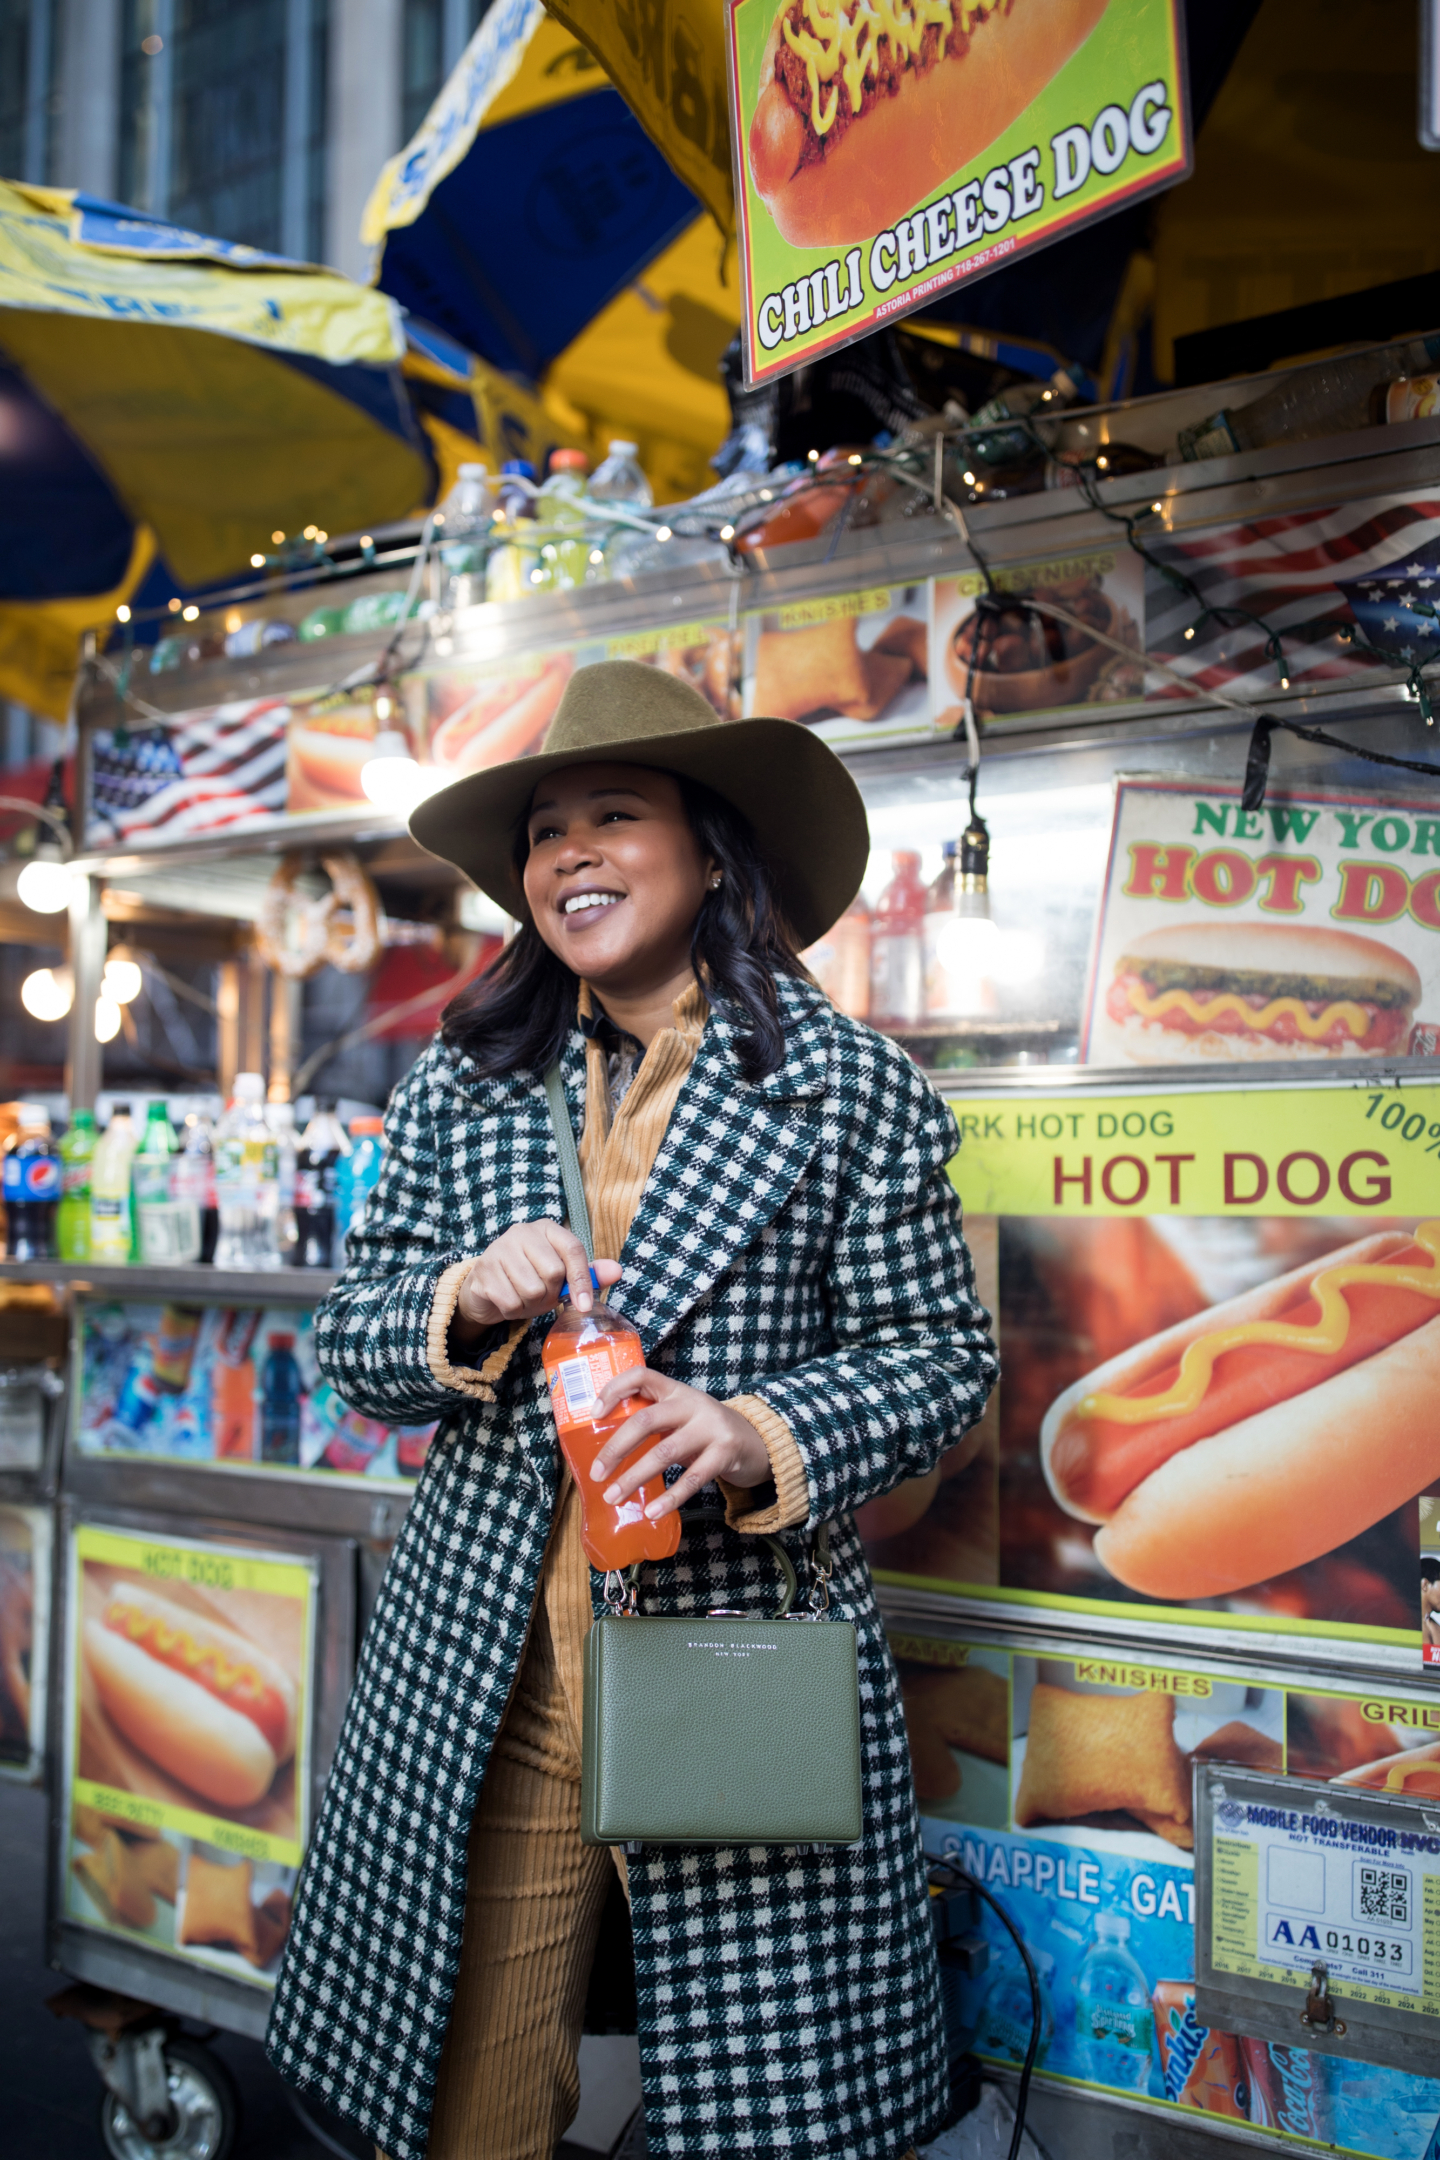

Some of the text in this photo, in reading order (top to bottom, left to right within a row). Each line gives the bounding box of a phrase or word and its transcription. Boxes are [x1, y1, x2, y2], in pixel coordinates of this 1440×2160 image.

[757, 78, 1173, 351] CHILI CHEESE DOG
[874, 237, 1017, 320] ASTORIA PRINTING 718-267-1201
[1191, 801, 1320, 845] NEW
[1122, 841, 1323, 915] HOT
[1016, 1113, 1085, 1139] HOT
[1097, 1110, 1174, 1138] DOG
[1053, 1150, 1393, 1206] HOT DOG
[187, 1557, 234, 1590] DOG
[1078, 1663, 1210, 1695] KNISHES
[1363, 1702, 1440, 1728] GRIL
[1247, 1805, 1298, 1831] MOBILE
[1301, 1814, 1338, 1835] FOOD
[1341, 1820, 1396, 1848] VENDOR
[1289, 1833, 1390, 1857] NOT TRANSFERABLE
[1272, 1920, 1321, 1951] AA
[1326, 1931, 1403, 1961] 01033
[1294, 1955, 1343, 1971] Compnts?
[1352, 1967, 1368, 1976] Call
[1370, 1971, 1385, 1980] 311
[1327, 1985, 1343, 1995] 2021
[1350, 1990, 1367, 2000] 2022
[1374, 1995, 1390, 2005] 2023
[1398, 2000, 1415, 2010] 2024
[1422, 2005, 1439, 2016] 2025
